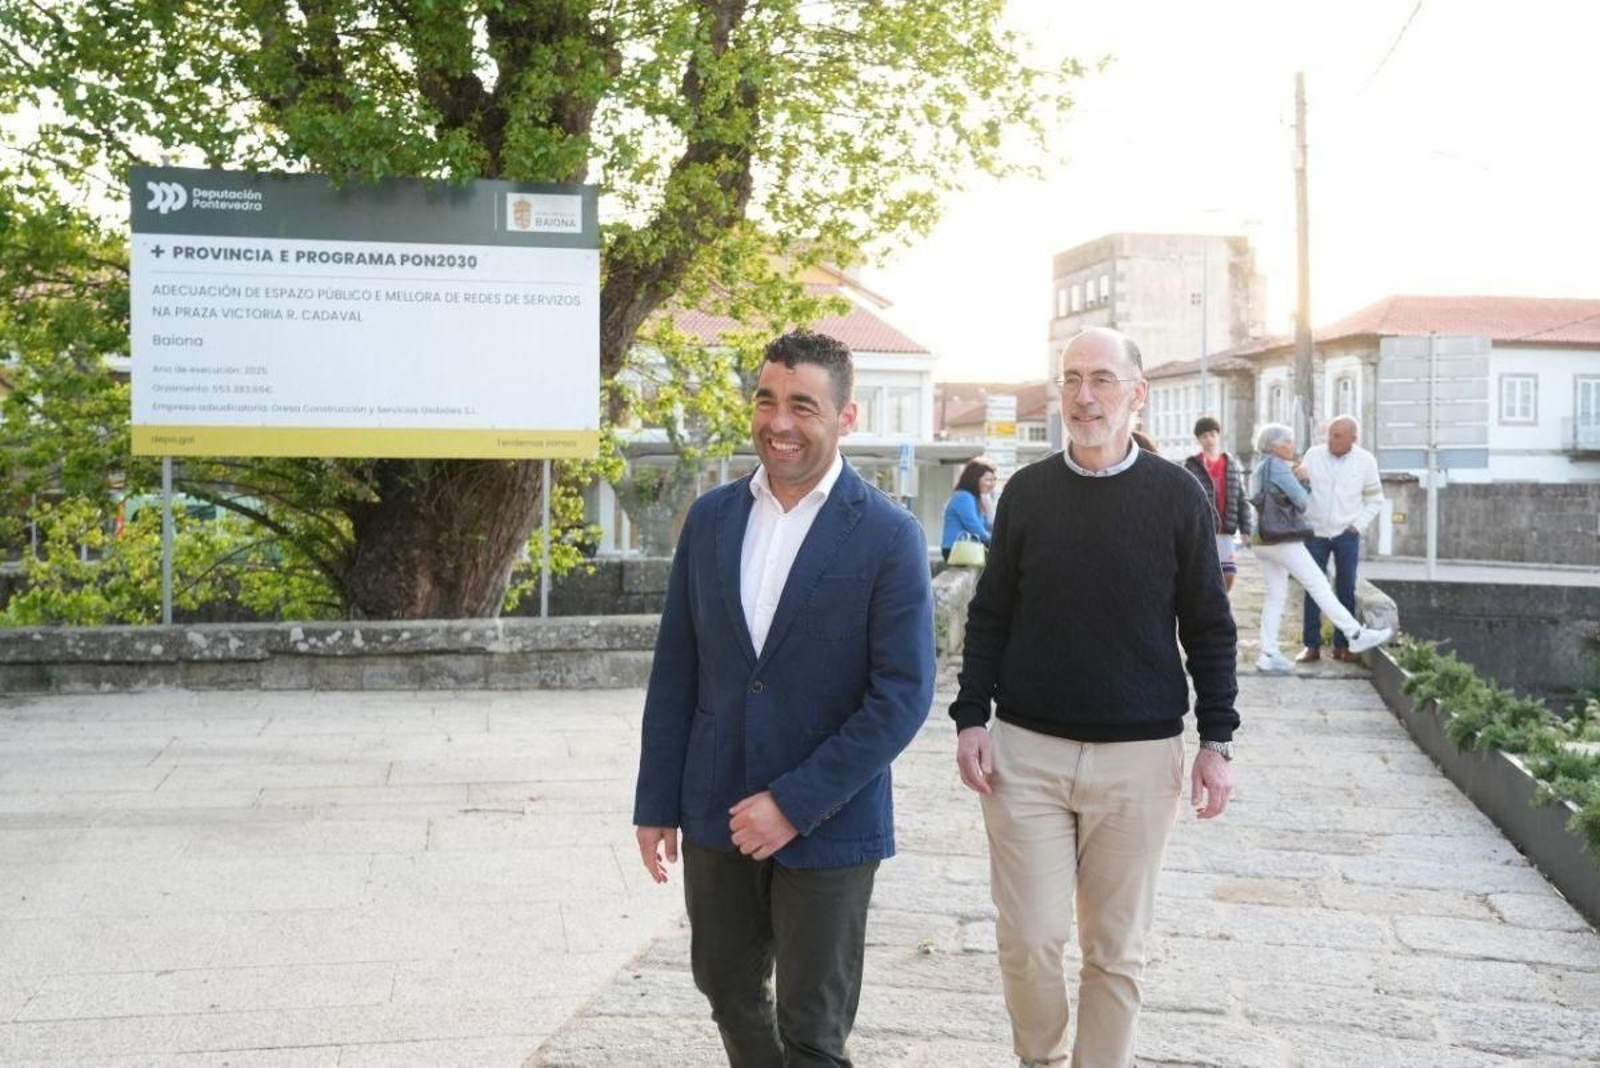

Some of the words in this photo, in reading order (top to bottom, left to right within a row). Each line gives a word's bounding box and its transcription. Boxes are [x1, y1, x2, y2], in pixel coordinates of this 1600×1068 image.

[192, 187, 262, 201] Deputación
[192, 199, 262, 211] Pontevedra
[534, 217, 577, 228] BAIONA
[172, 246, 274, 262] PROVINCIA
[280, 250, 289, 263] E
[296, 250, 397, 266] PROGRAMA
[400, 253, 478, 268] PON2030
[152, 283, 241, 298] ADECUACIÓN
[245, 287, 260, 298] DE
[265, 286, 314, 299] ESPAZO
[318, 286, 372, 301] PÚBLICO
[375, 290, 382, 301] E
[385, 290, 441, 303] MELLORA
[445, 293, 459, 303] DE
[464, 293, 501, 304] REDES
[504, 294, 520, 305] DE
[523, 294, 581, 306] SERVIZOS
[152, 306, 173, 318] NA
[175, 307, 218, 319] PRAZA
[222, 308, 283, 320] VICTORIA
[287, 310, 298, 321] R.
[302, 310, 363, 322] CADAVAL
[152, 334, 204, 347] Baiona
